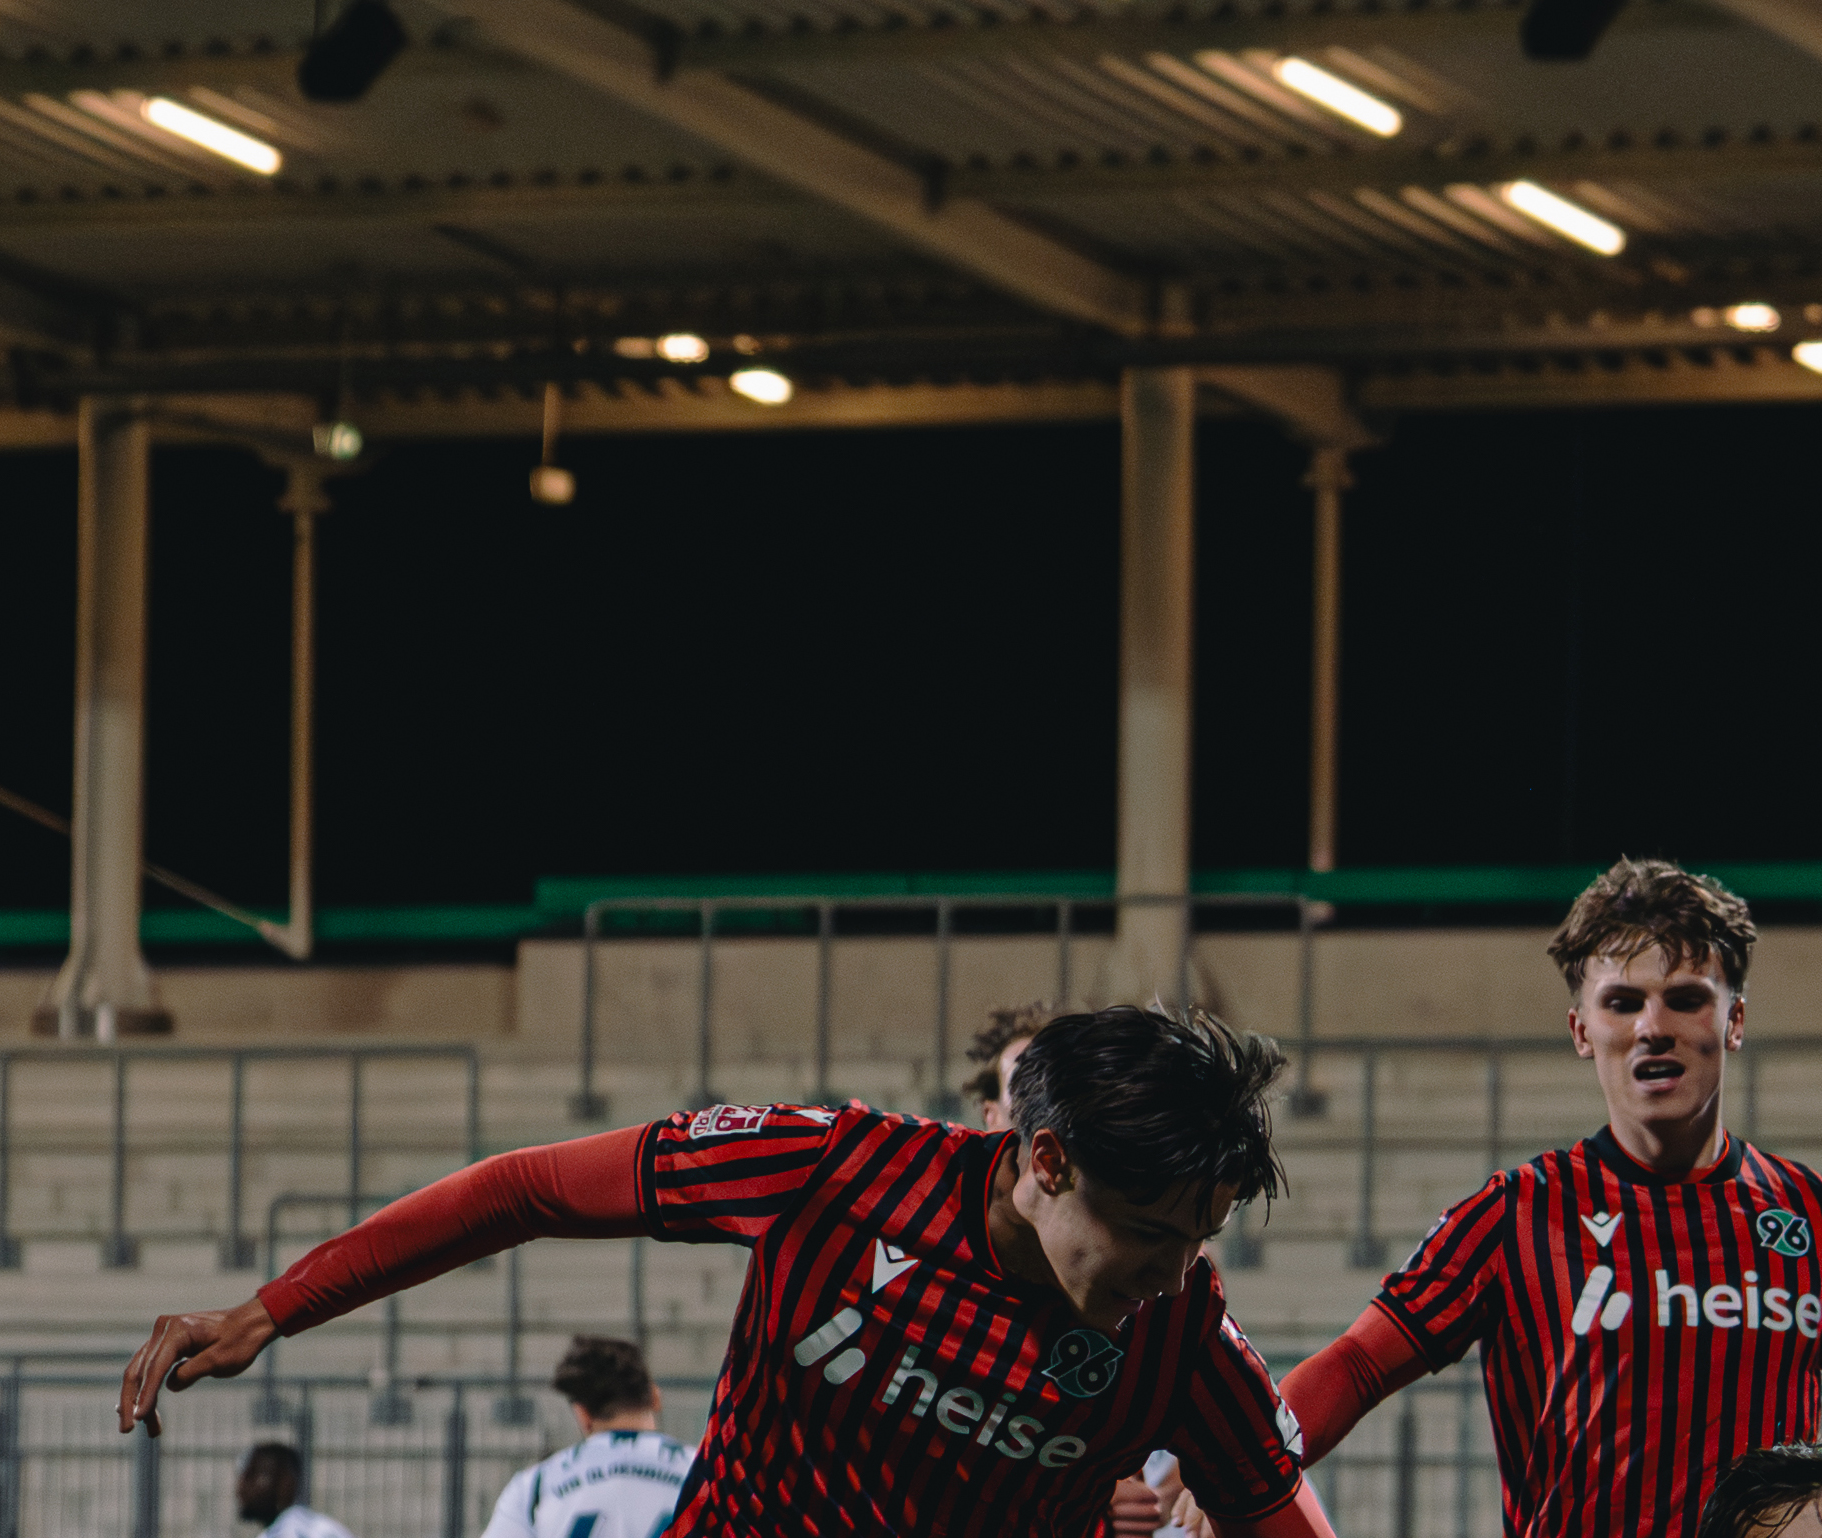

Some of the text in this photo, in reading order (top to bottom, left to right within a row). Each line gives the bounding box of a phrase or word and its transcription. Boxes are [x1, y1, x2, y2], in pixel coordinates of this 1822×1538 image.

[1756, 1209, 1811, 1257] 96
[1656, 1269, 1821, 1340] heise
[1041, 1329, 1125, 1398] 96
[881, 1345, 1088, 1468] heise
